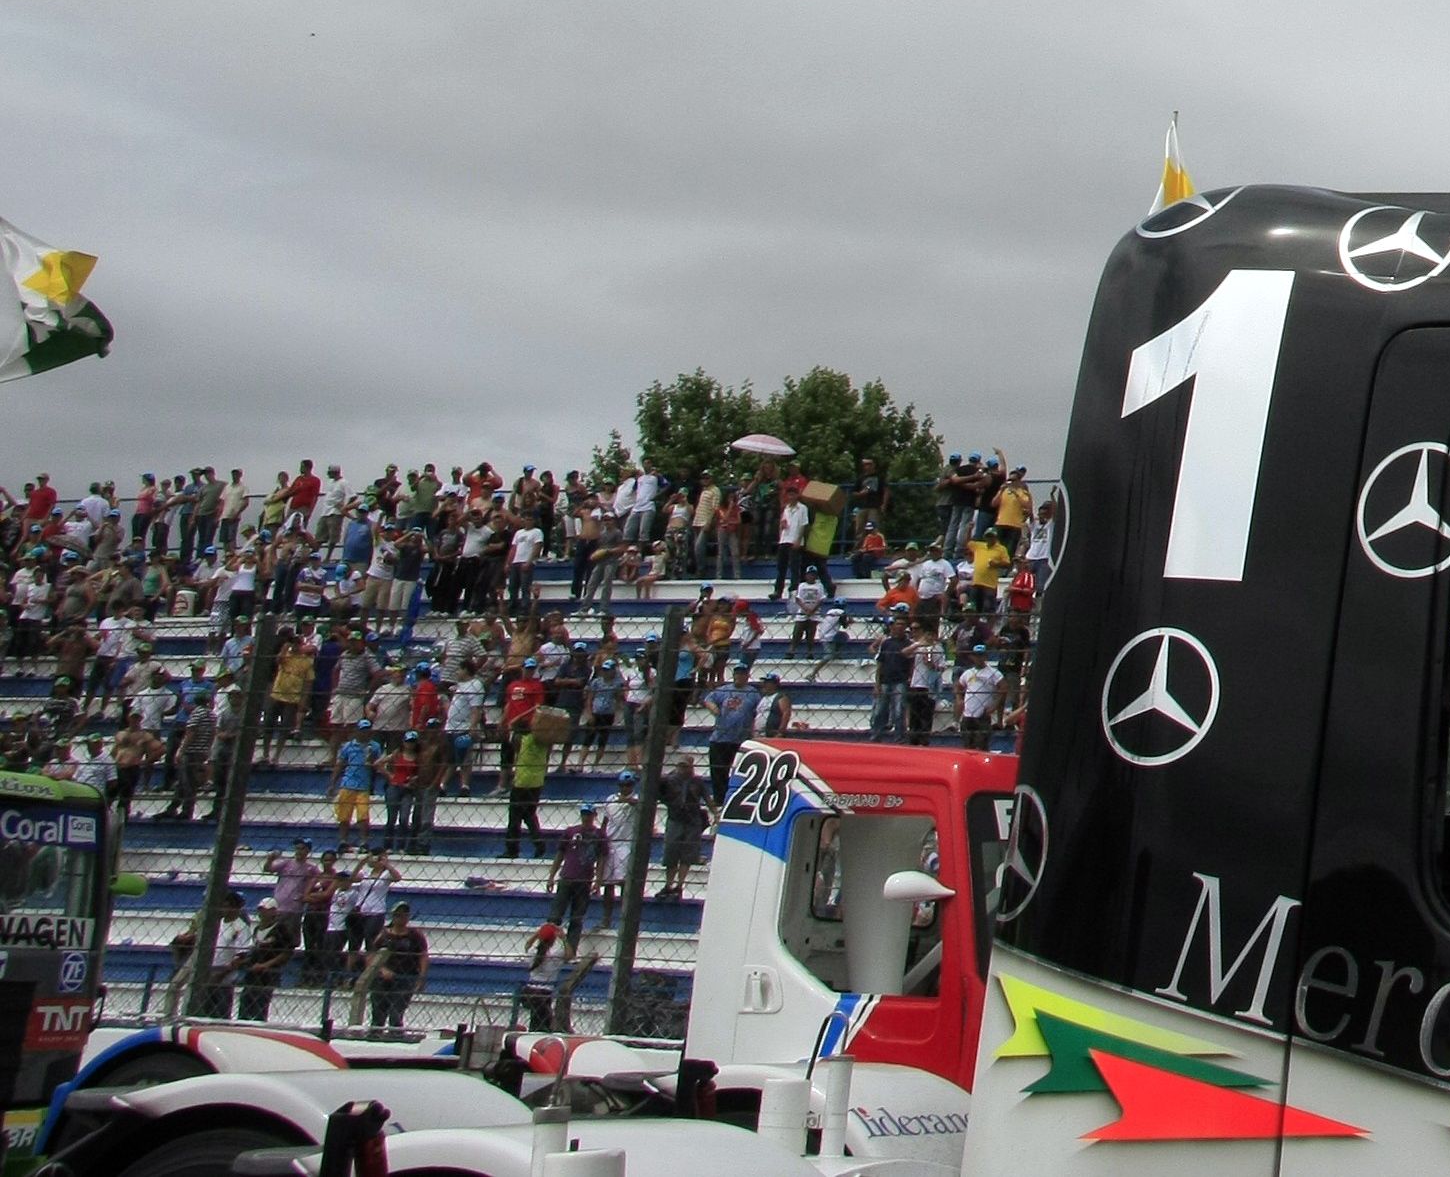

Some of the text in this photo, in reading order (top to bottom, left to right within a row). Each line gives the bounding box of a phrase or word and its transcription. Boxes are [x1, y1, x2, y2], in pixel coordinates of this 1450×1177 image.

[1121, 269, 1296, 581] 1
[720, 749, 800, 827] 28
[0, 808, 65, 843] Coral
[36, 1005, 91, 1031] TNT
[848, 1107, 969, 1138] lideran
